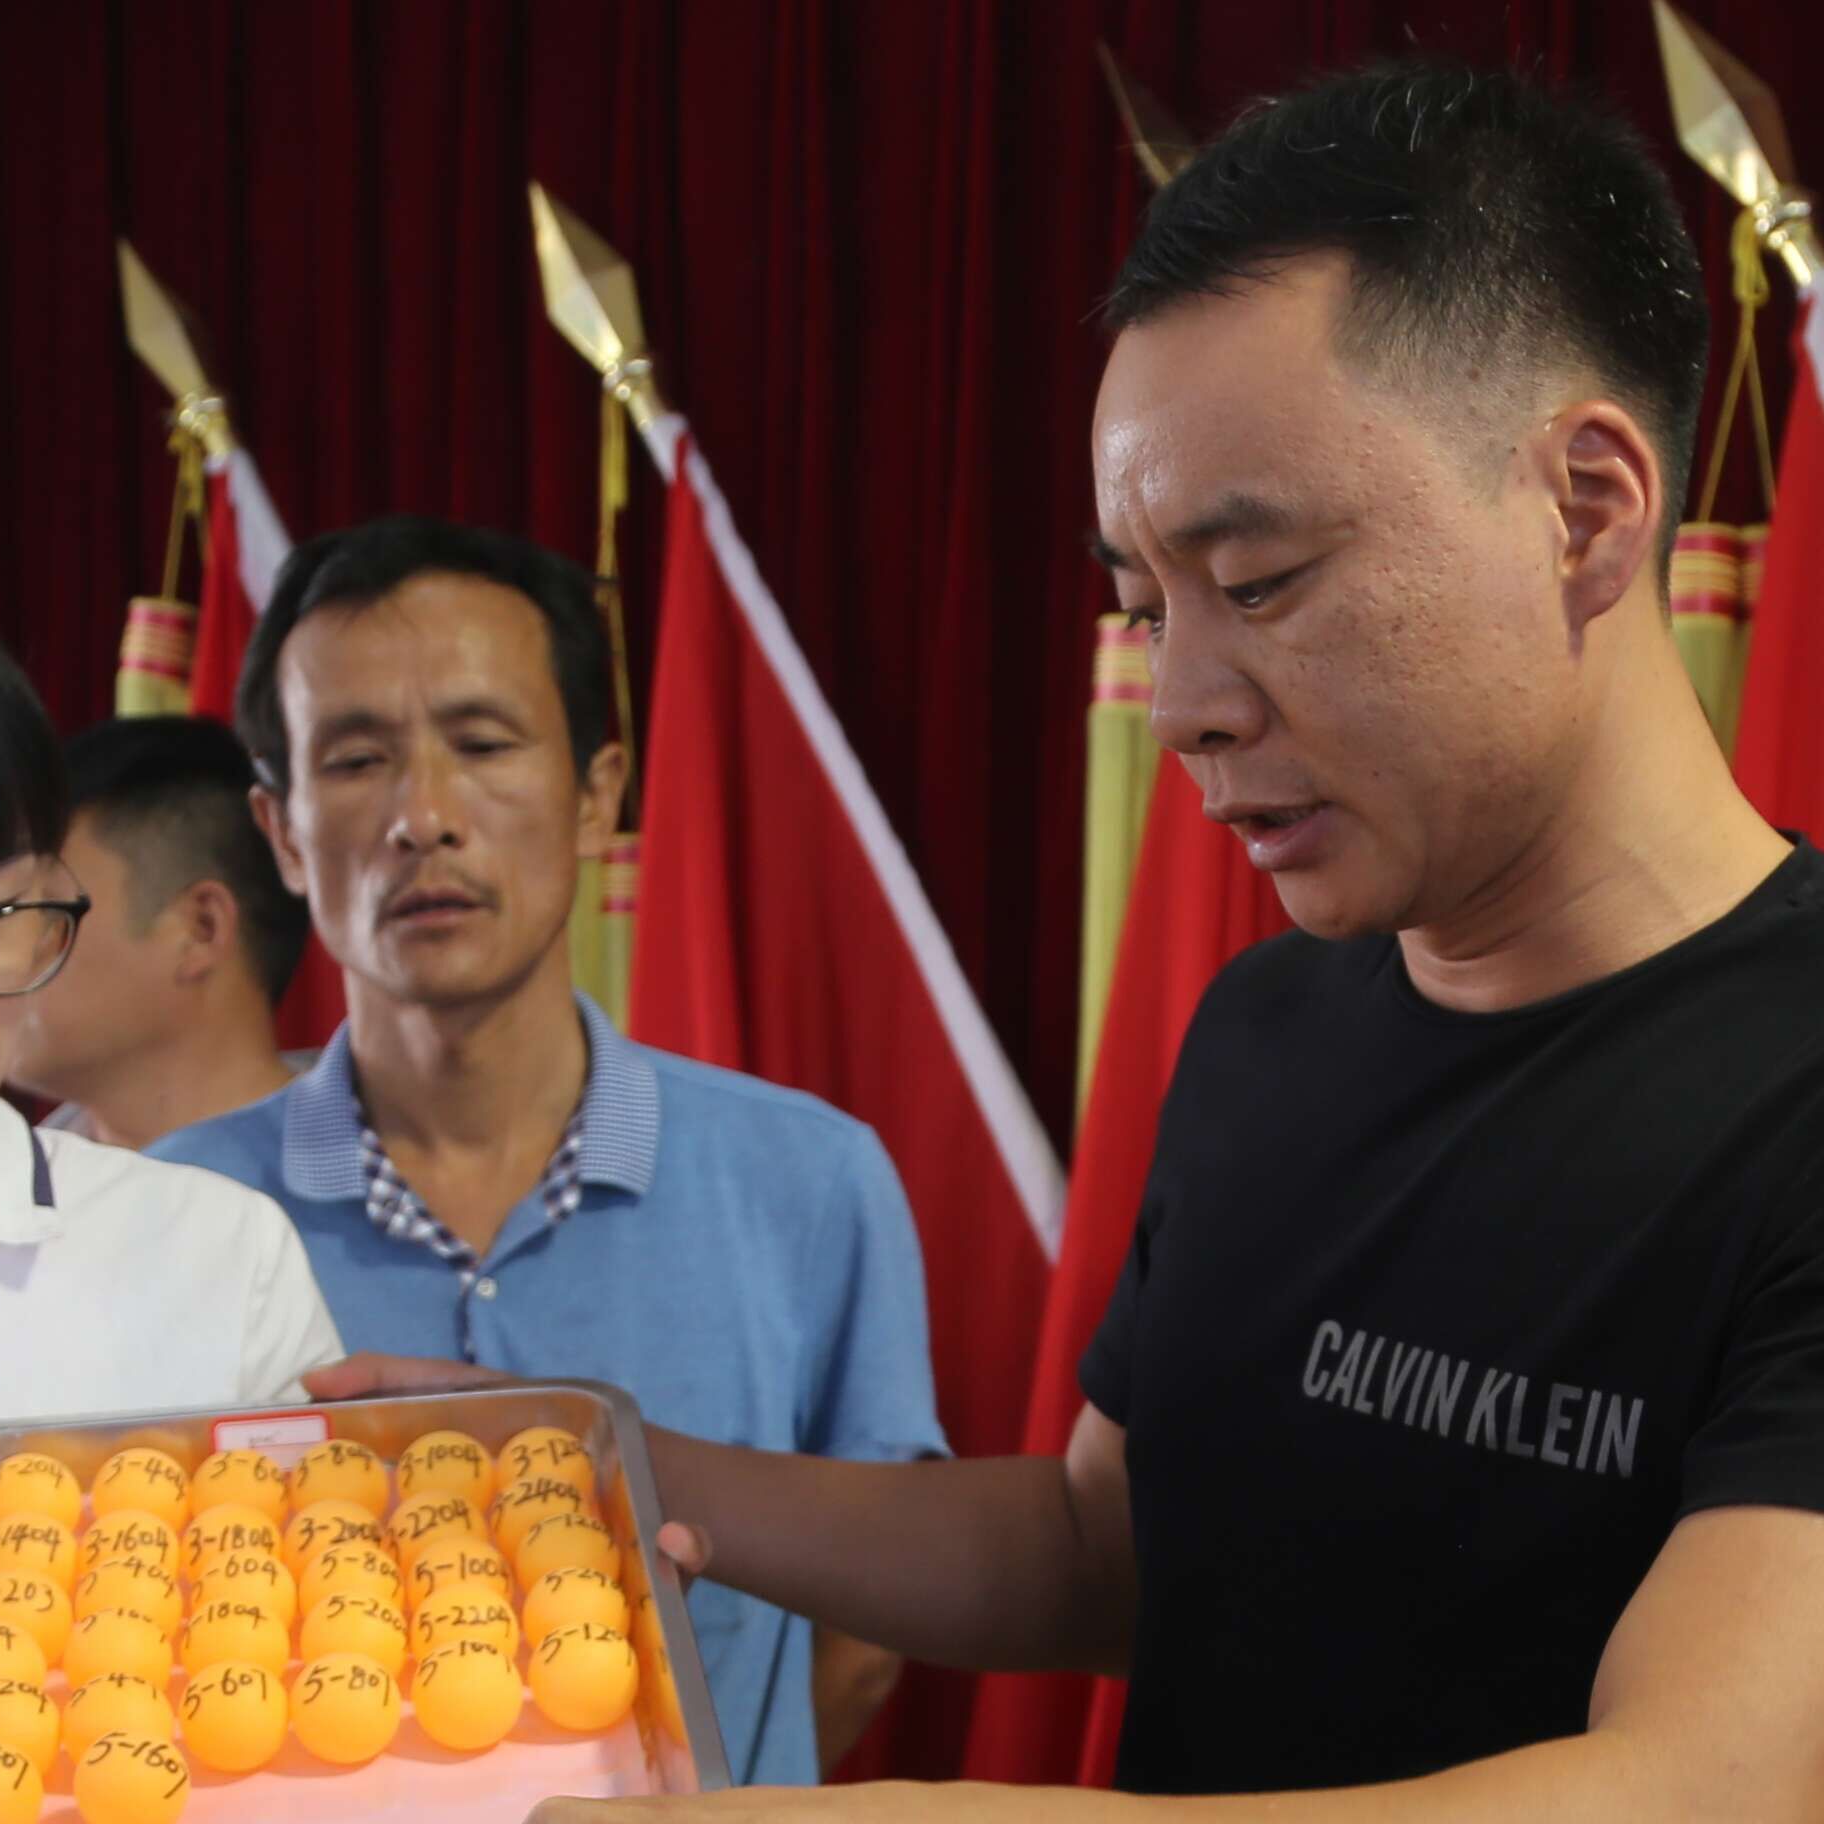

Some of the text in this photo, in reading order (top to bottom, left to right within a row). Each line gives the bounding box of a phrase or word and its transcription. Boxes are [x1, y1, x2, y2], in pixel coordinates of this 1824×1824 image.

[1302, 1319, 1645, 1479] CALVIN KLEIN
[85, 1523, 169, 1564] 3-1604
